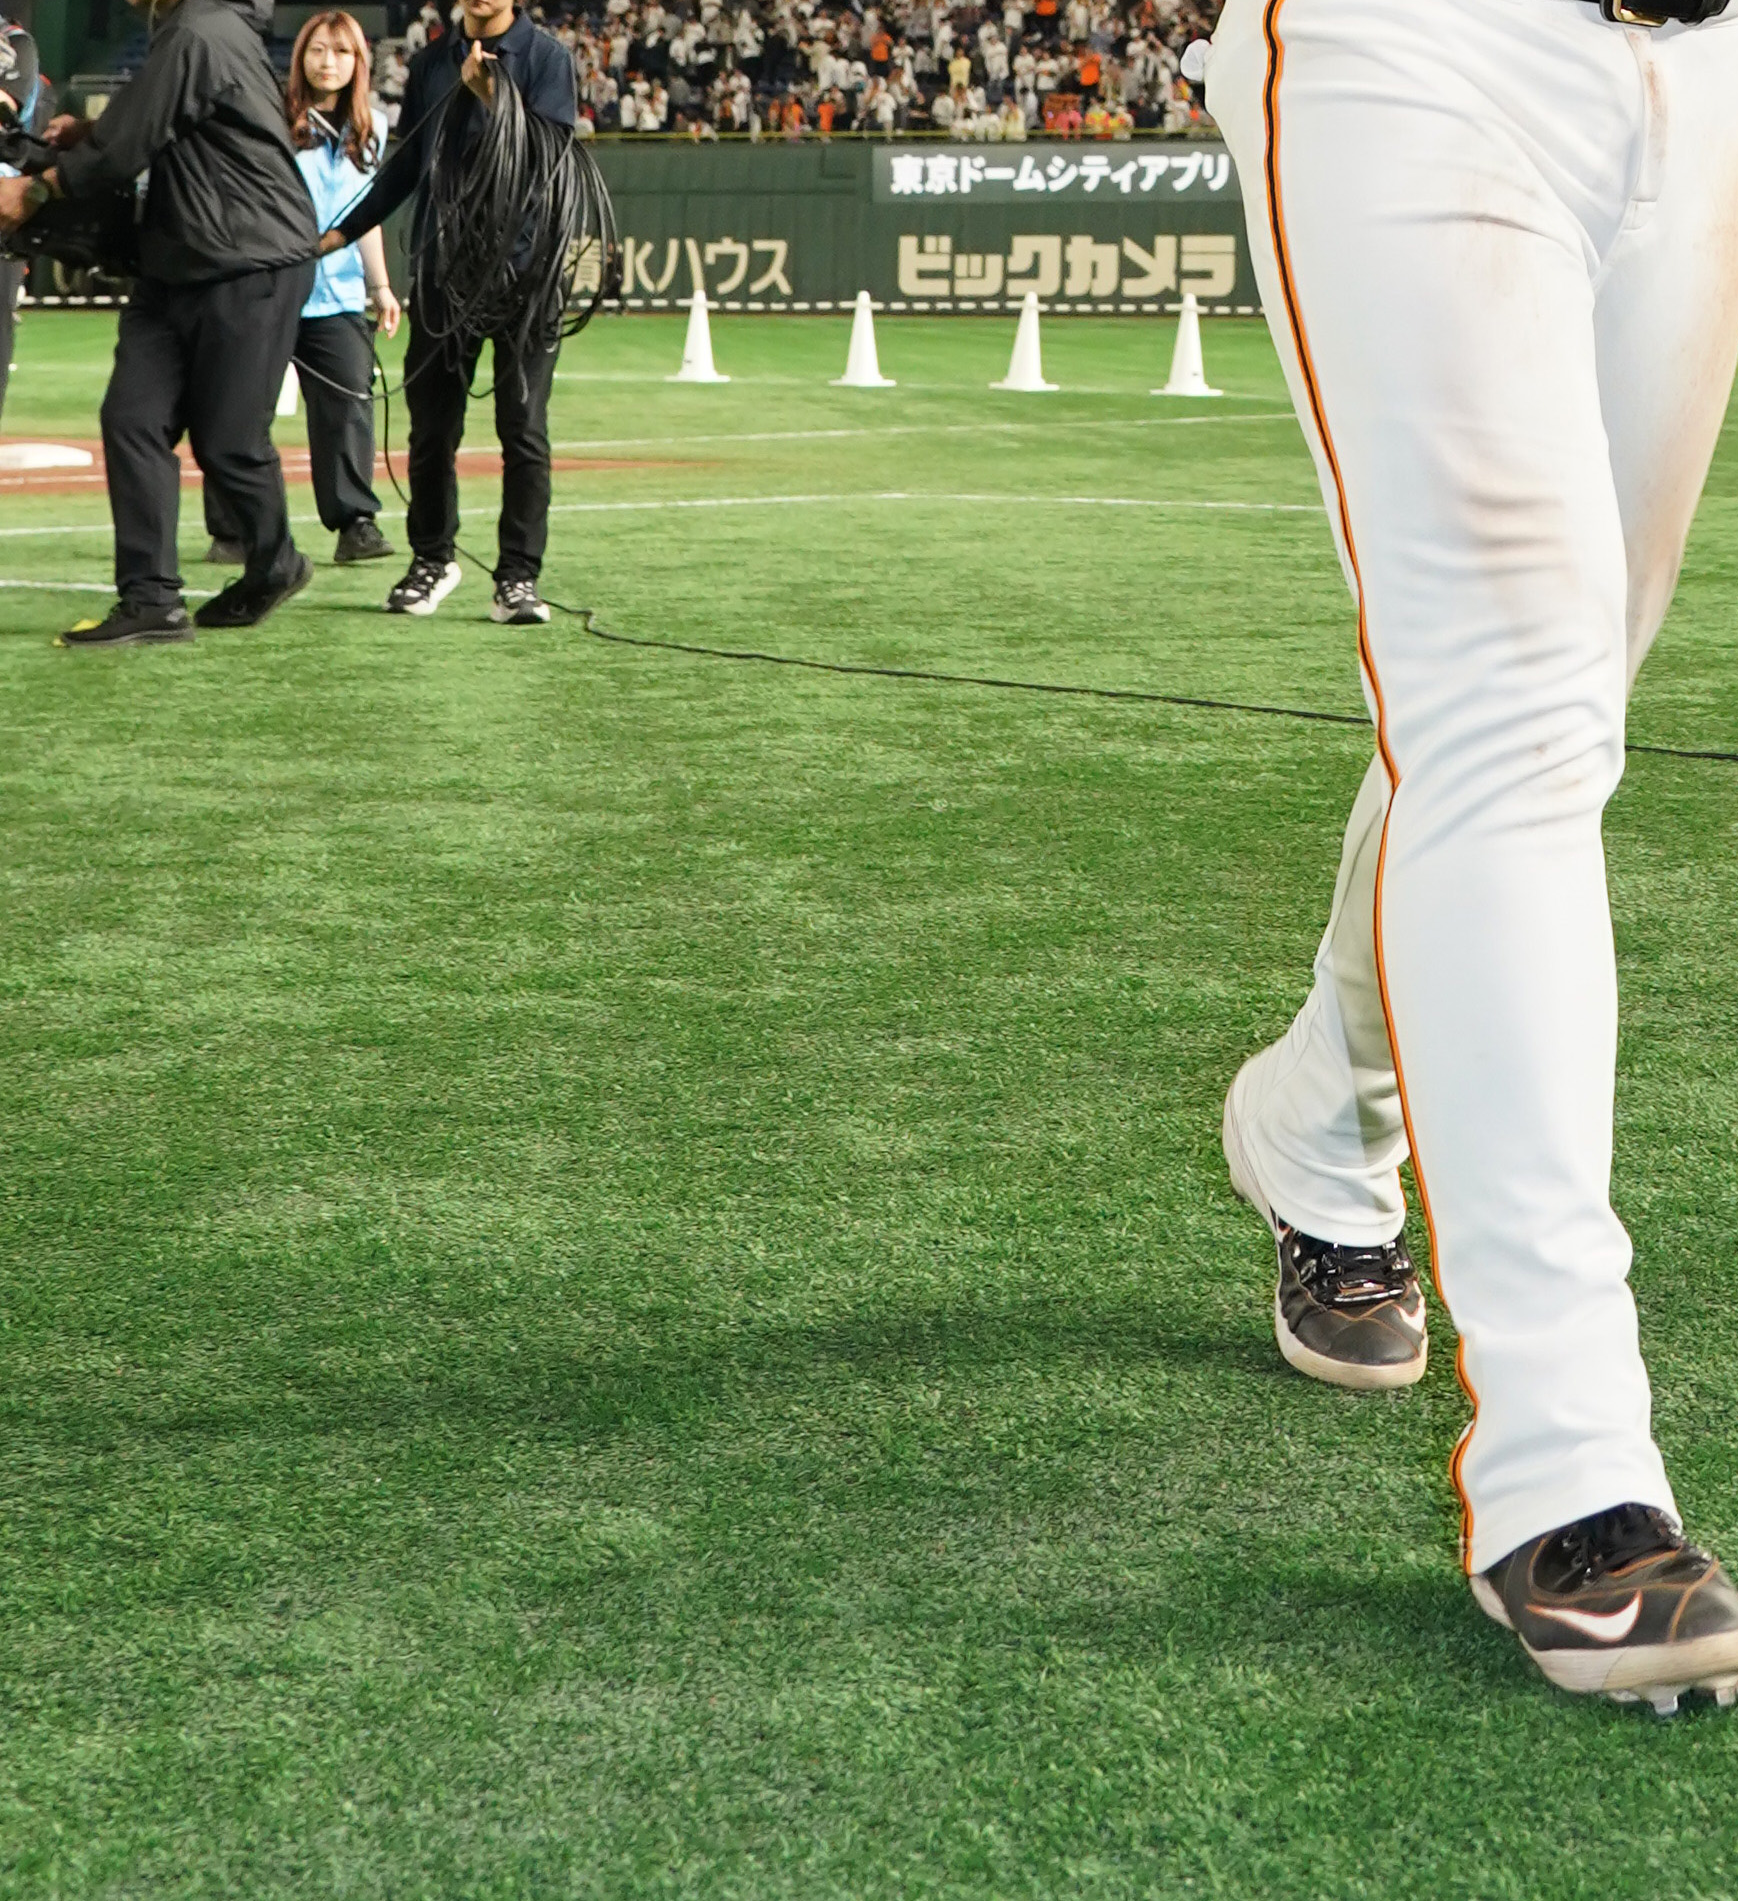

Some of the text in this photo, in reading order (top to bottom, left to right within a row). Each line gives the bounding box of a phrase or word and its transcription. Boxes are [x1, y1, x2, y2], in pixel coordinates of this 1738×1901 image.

[890, 152, 1231, 194] 東京ドームシティアプリ
[898, 234, 1236, 298] ビックカメラ
